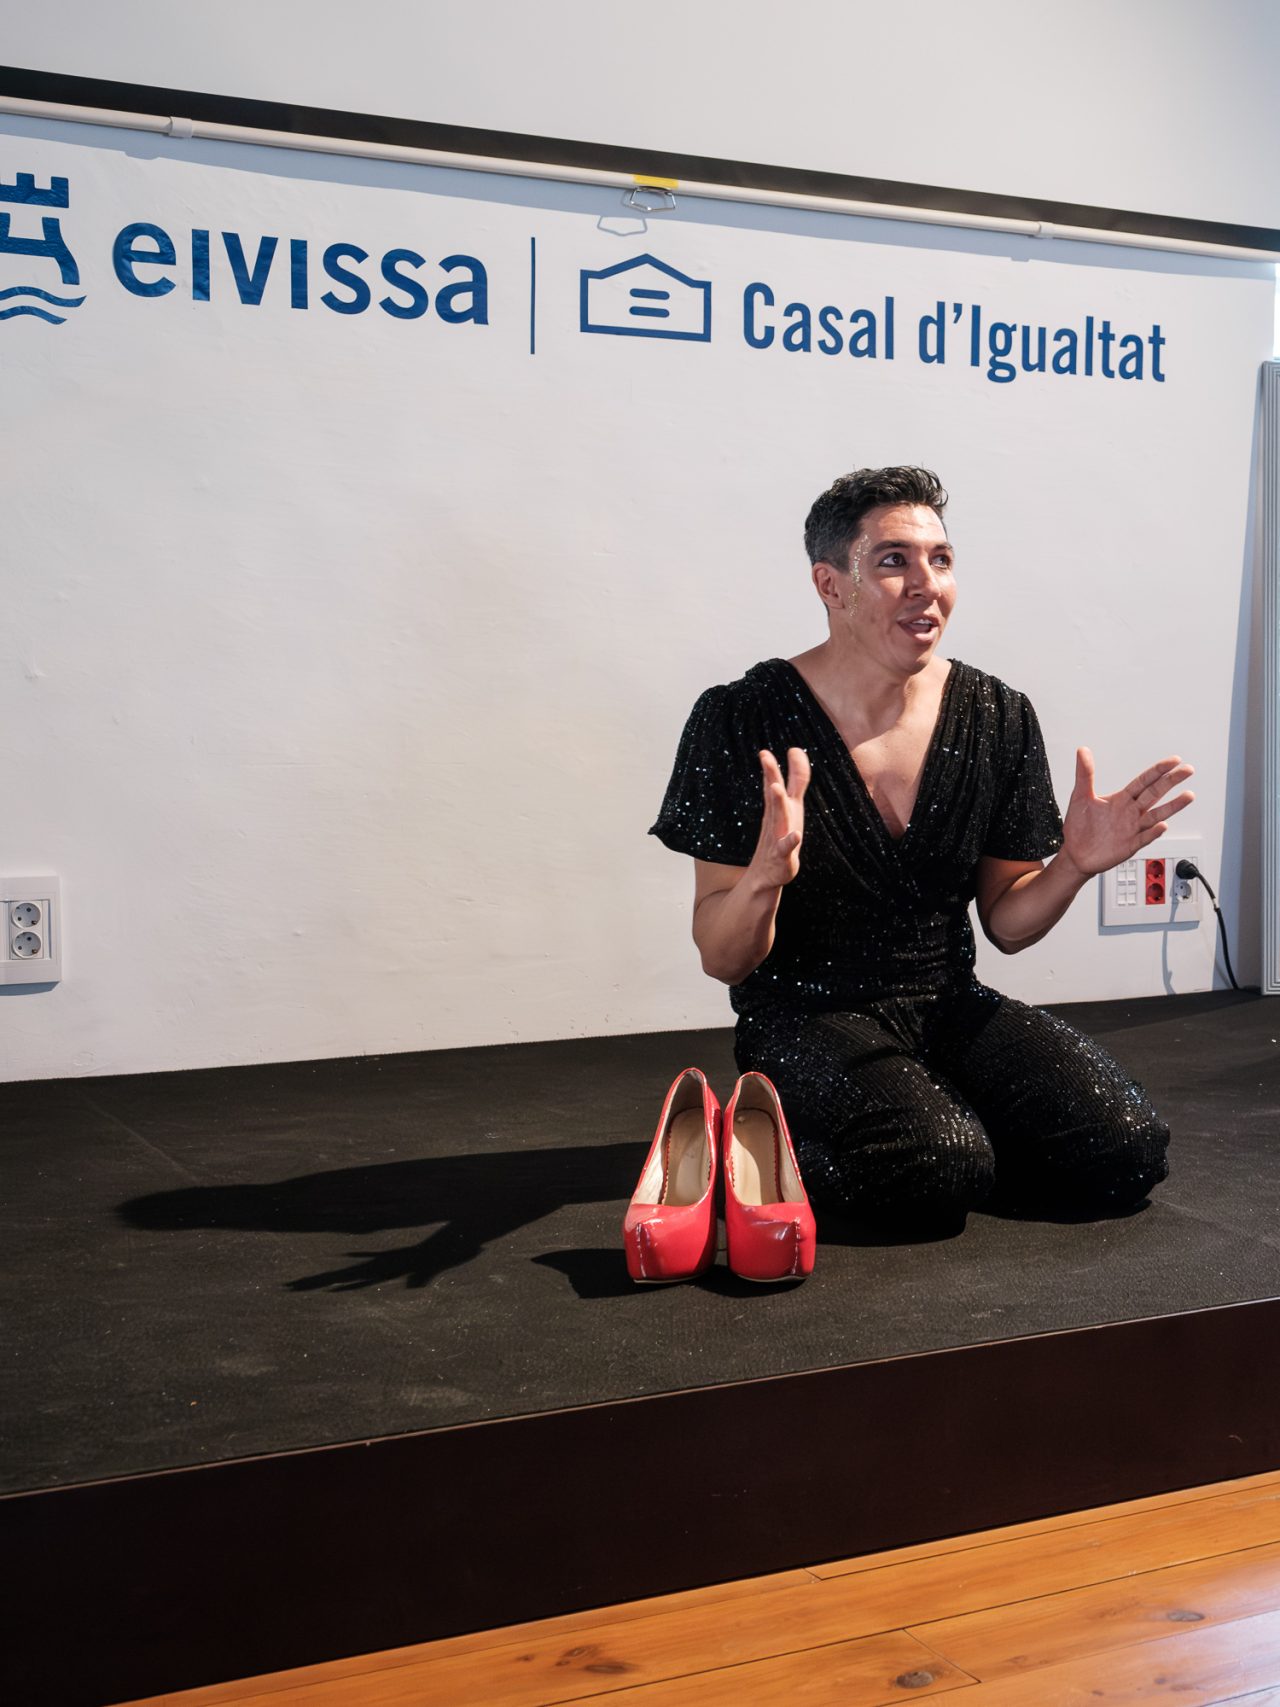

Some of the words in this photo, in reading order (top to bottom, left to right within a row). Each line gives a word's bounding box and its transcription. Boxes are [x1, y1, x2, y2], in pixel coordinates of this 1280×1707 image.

[112, 221, 489, 326] eivissa
[743, 282, 895, 360] Casal
[918, 300, 1166, 383] d'Igualtat
